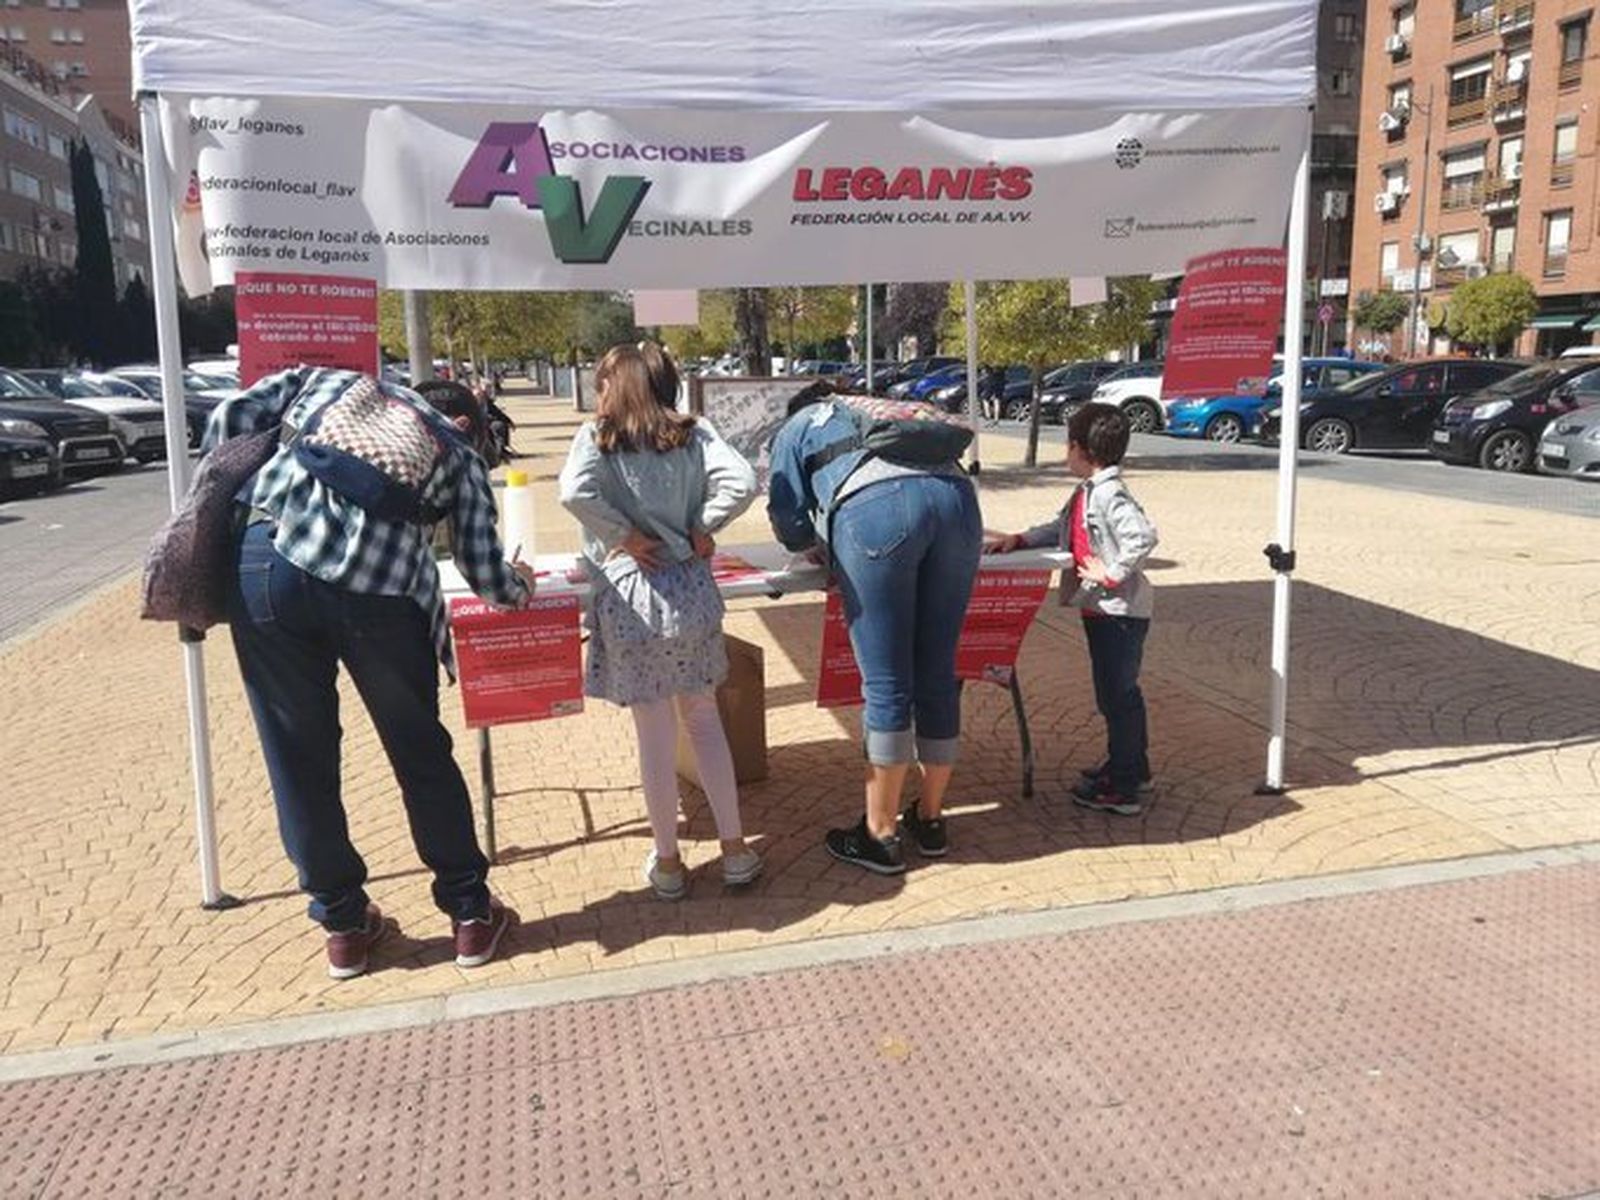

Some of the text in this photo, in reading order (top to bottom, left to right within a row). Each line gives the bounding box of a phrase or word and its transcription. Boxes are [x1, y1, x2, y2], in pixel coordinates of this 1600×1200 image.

[792, 161, 1034, 202] LEGANÉS
[790, 211, 894, 226] FEDERACIÓN
[896, 211, 951, 224] LOCAL
[955, 211, 977, 224] DE
[318, 229, 358, 244] local
[361, 230, 382, 244] de
[385, 231, 490, 246] Asociaciones
[275, 244, 298, 260] de
[276, 283, 298, 294] NO
[301, 284, 318, 295] TE
